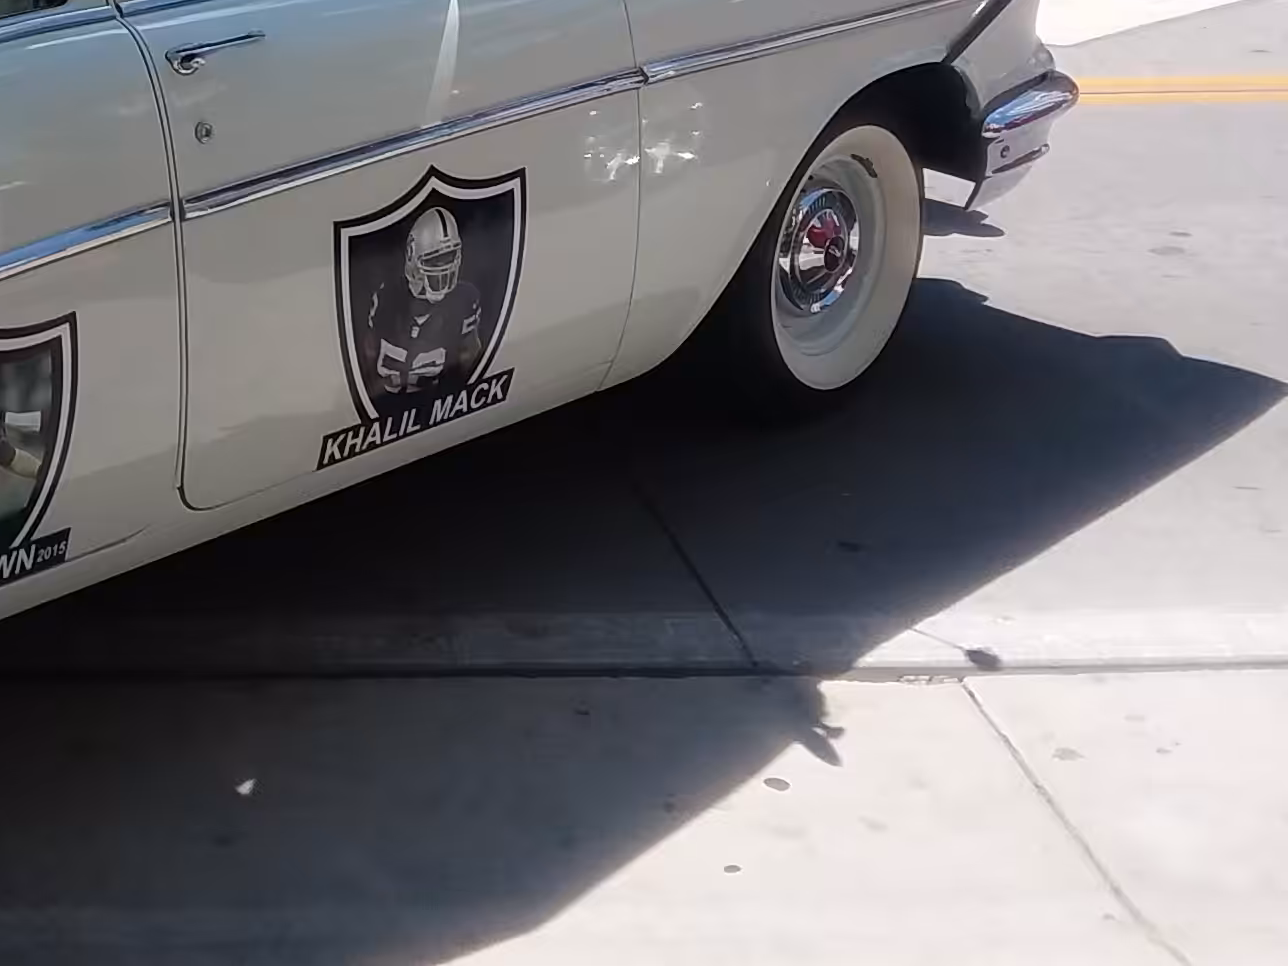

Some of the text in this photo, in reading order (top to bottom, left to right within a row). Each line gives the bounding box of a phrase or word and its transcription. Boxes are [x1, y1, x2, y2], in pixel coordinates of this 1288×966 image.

[322, 374, 509, 465] KHALIL MACK
[37, 541, 68, 564] 2015
